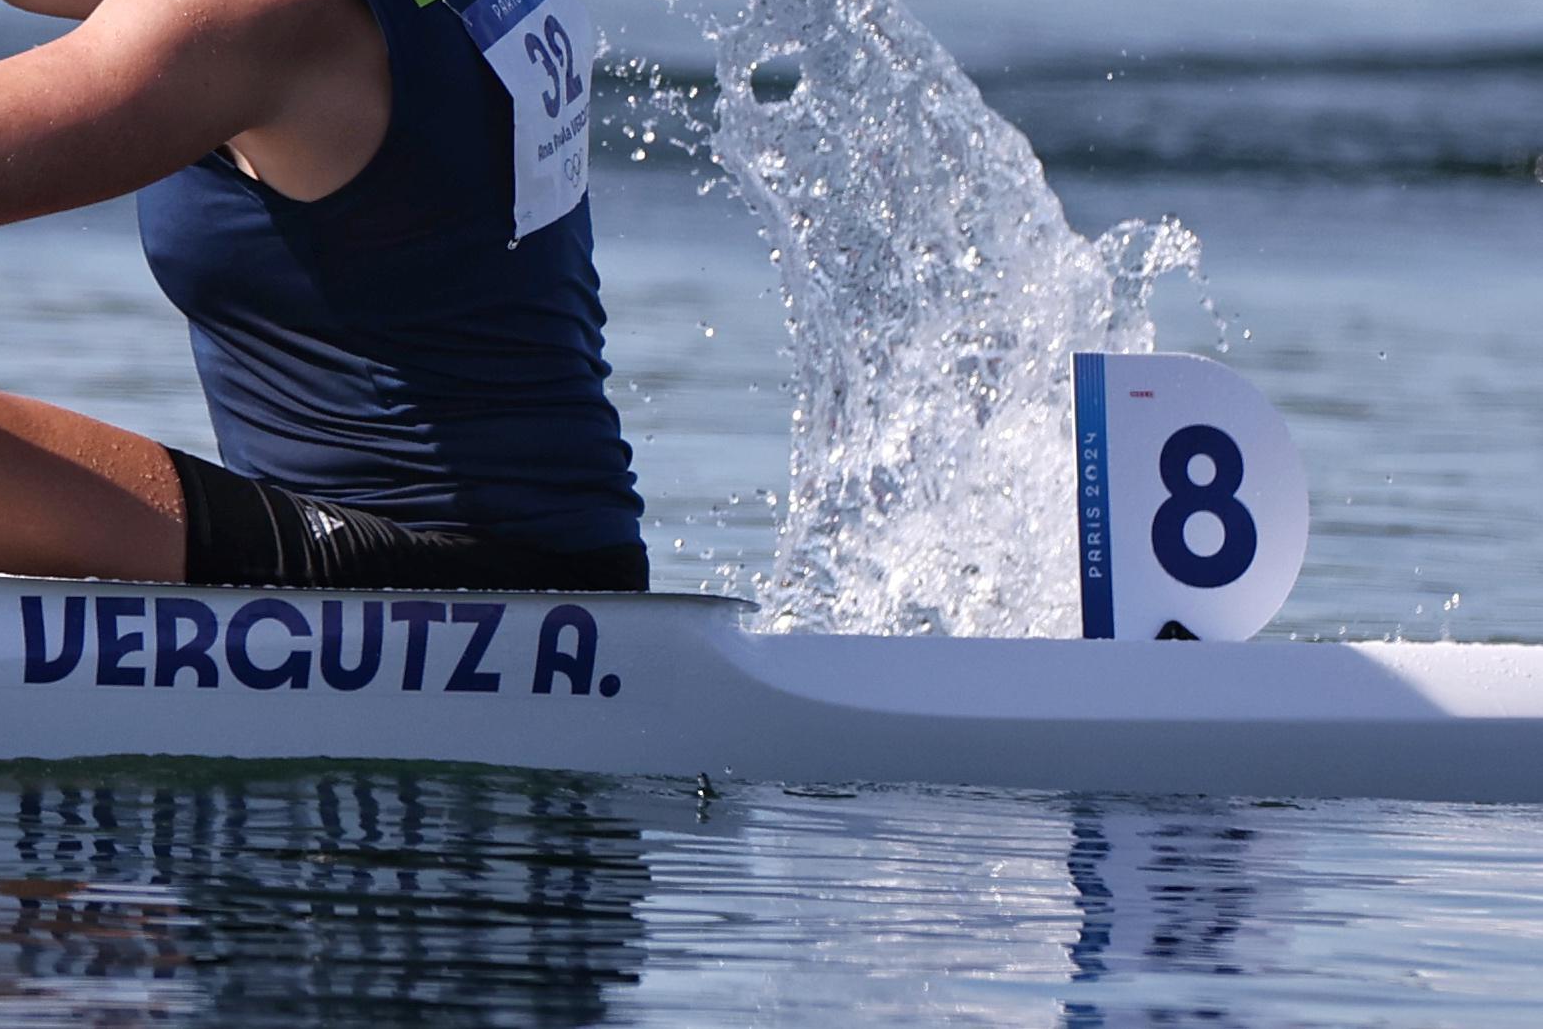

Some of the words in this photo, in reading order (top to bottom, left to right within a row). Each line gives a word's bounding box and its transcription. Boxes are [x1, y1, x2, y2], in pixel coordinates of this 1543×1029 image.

[524, 14, 584, 119] 32
[1084, 431, 1100, 498] 2024
[1151, 424, 1257, 589] 8
[1086, 506, 1103, 579] PARIS
[20, 595, 506, 692] VERGUTZ
[532, 603, 622, 698] A.
